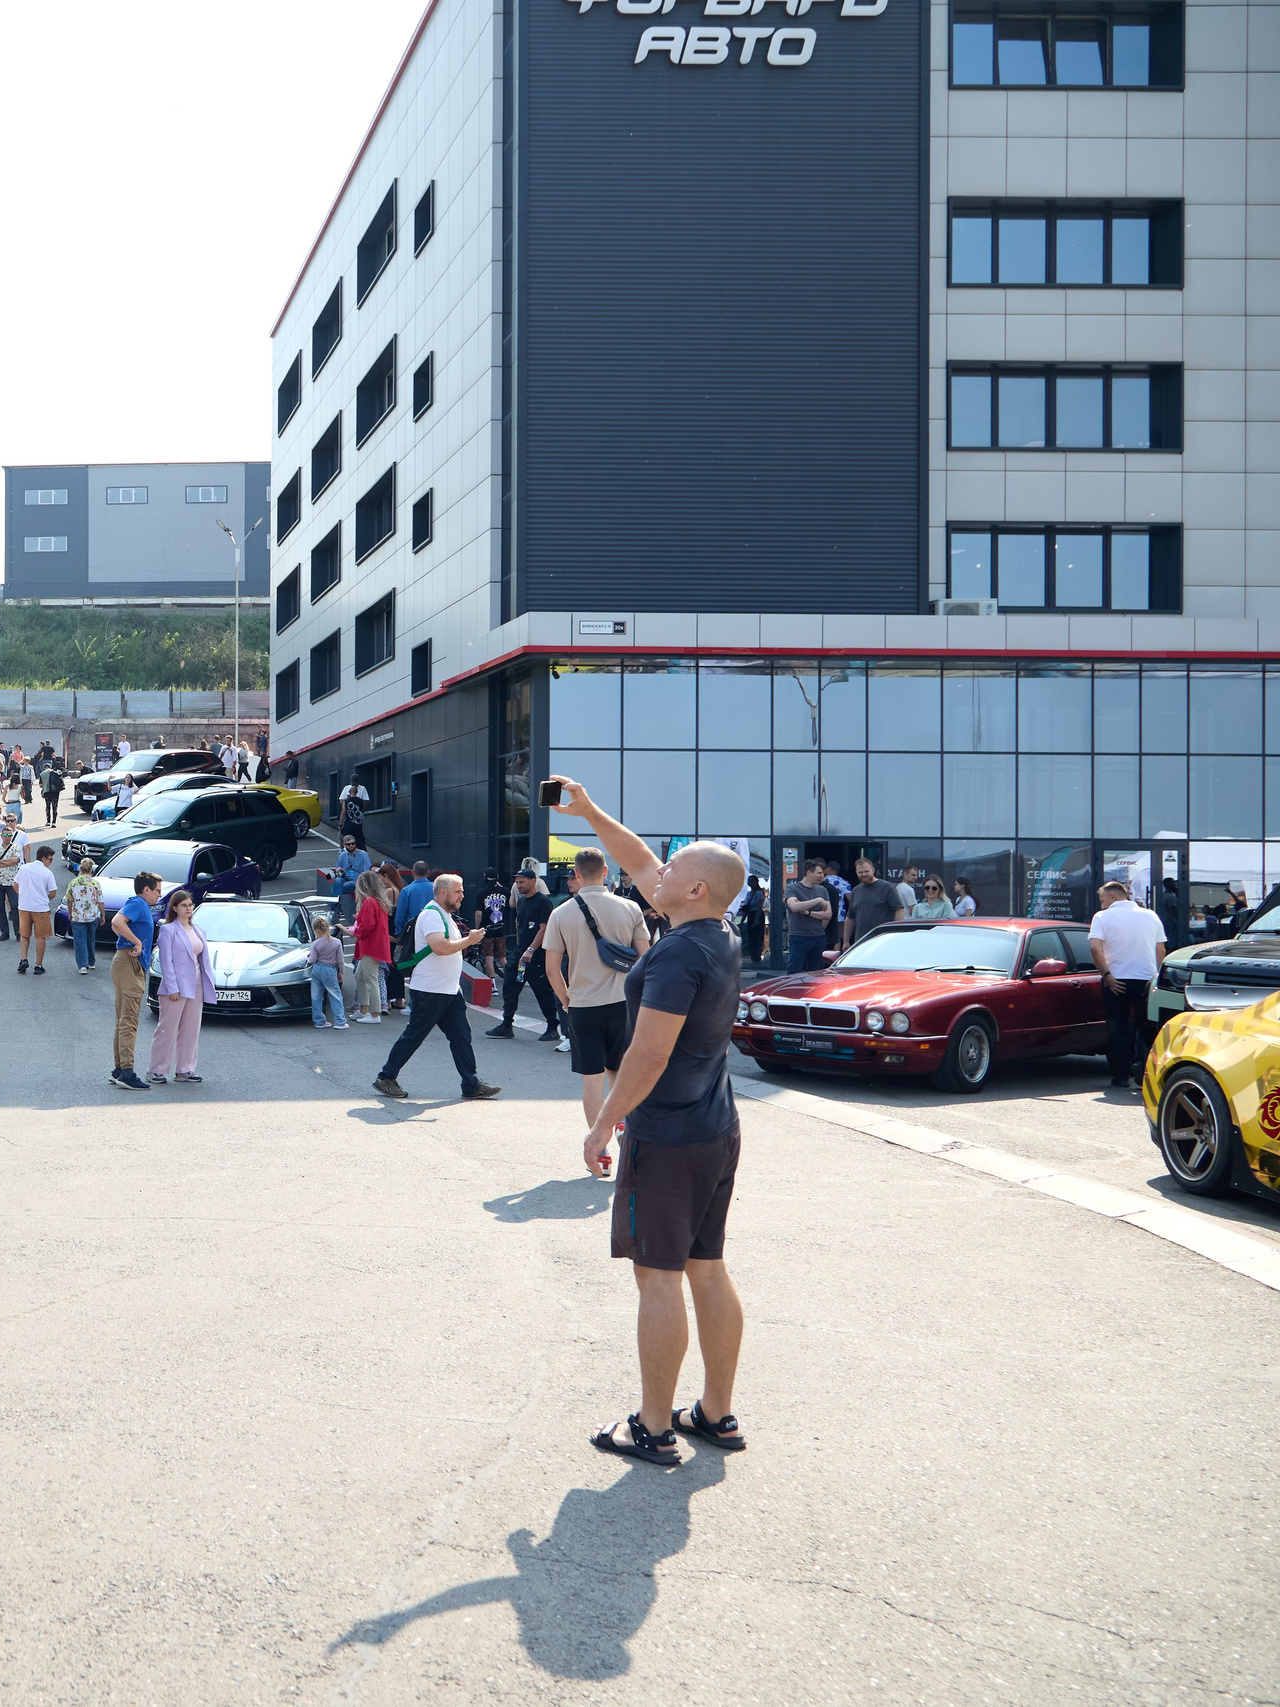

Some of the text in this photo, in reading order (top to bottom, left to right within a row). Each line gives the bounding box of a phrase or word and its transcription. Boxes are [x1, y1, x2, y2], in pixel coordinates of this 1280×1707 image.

[634, 26, 817, 65] АВТО
[1026, 870, 1067, 880] СЕРВИС
[236, 991, 249, 999] 124
